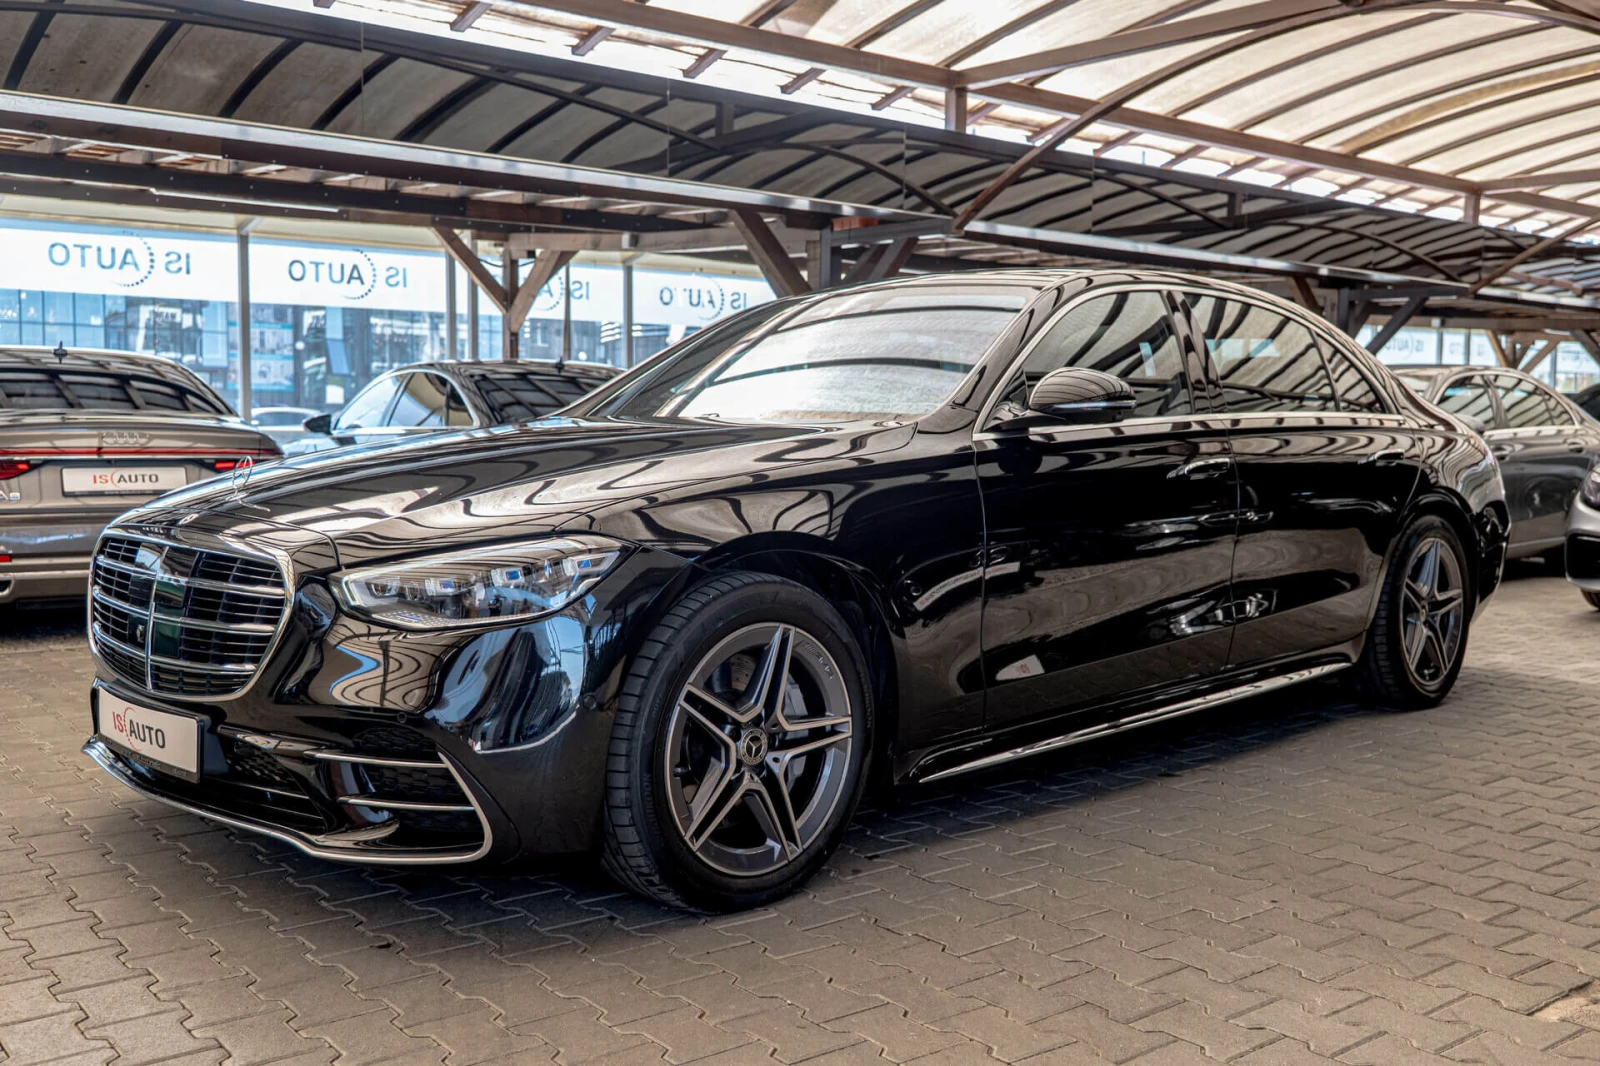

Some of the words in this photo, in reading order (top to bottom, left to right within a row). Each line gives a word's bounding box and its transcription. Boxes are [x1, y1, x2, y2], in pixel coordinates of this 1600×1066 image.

[92, 474, 109, 484] IS
[117, 473, 159, 484] AUTO
[112, 711, 125, 733] IS
[129, 719, 166, 749] AUTO
